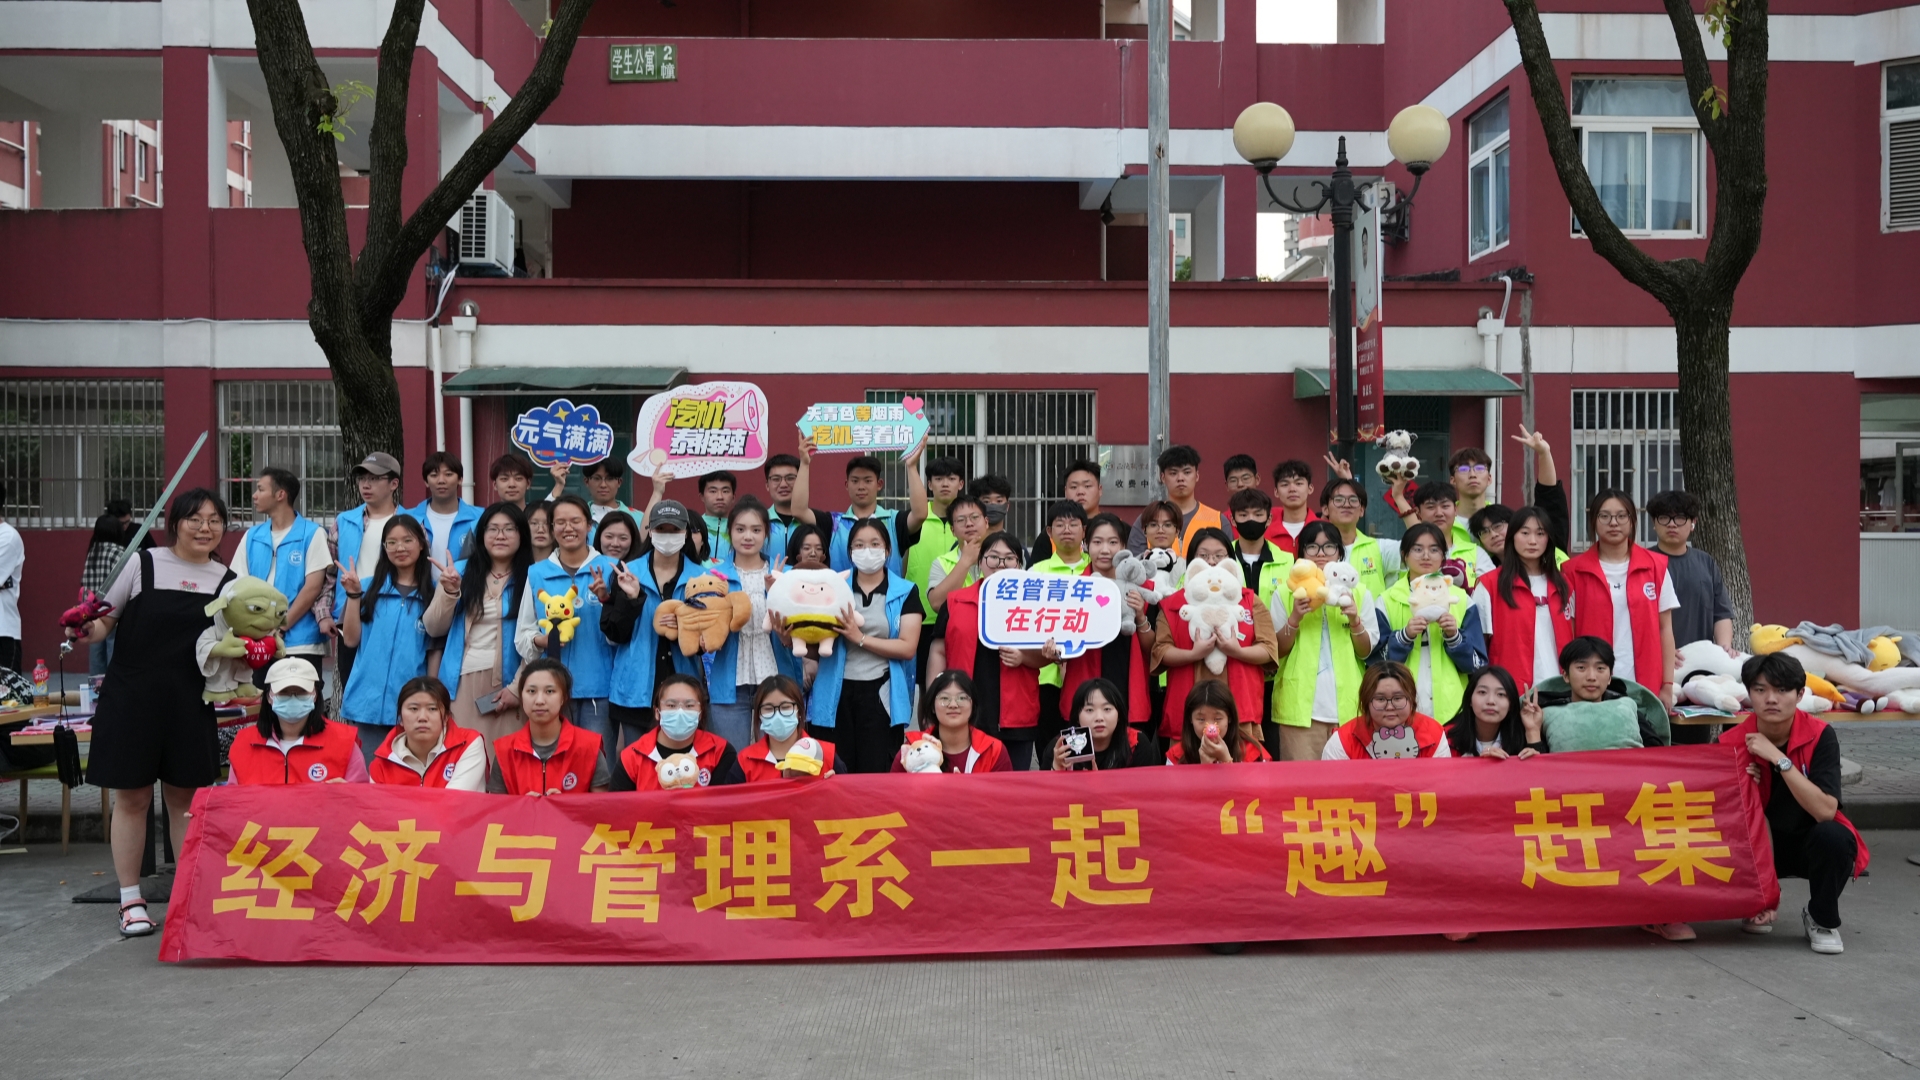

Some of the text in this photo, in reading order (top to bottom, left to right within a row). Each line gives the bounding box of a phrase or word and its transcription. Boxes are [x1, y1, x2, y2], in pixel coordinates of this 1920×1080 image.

[612, 47, 655, 76] 学生公寓
[665, 397, 726, 430] 汽机
[806, 405, 905, 422] 天青色等烟雨
[518, 418, 610, 455] 元气满满
[811, 424, 915, 446] 汽机等着你
[995, 577, 1094, 602] 经管青年
[1005, 605, 1090, 633] 在行动
